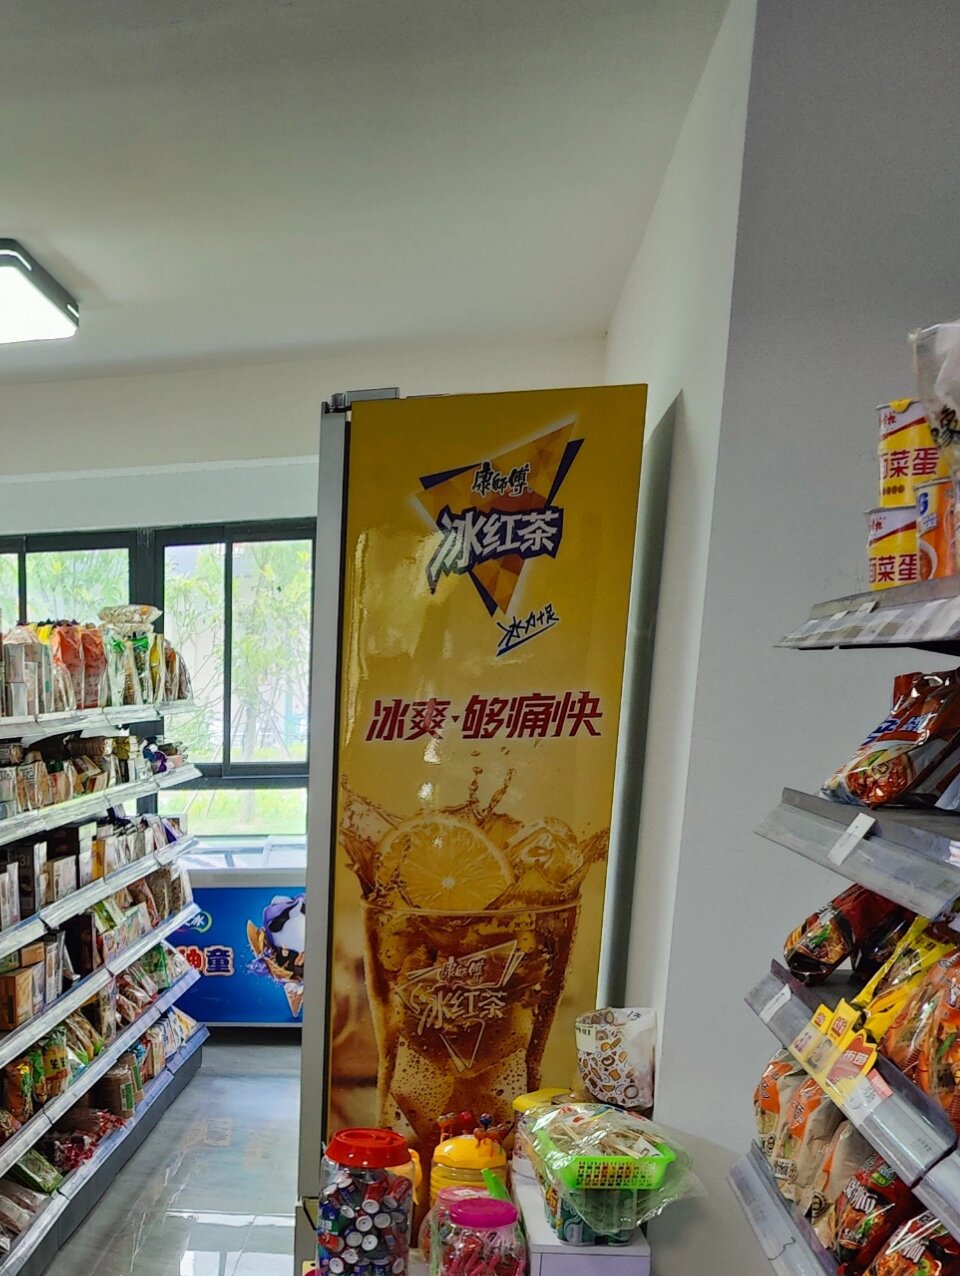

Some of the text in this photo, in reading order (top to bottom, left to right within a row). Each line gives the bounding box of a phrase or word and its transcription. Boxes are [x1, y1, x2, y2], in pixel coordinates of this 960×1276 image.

[431, 508, 561, 585] 冰红茶
[365, 691, 603, 742] 冰爽·够痛快
[418, 989, 508, 1036] 冰红茶
